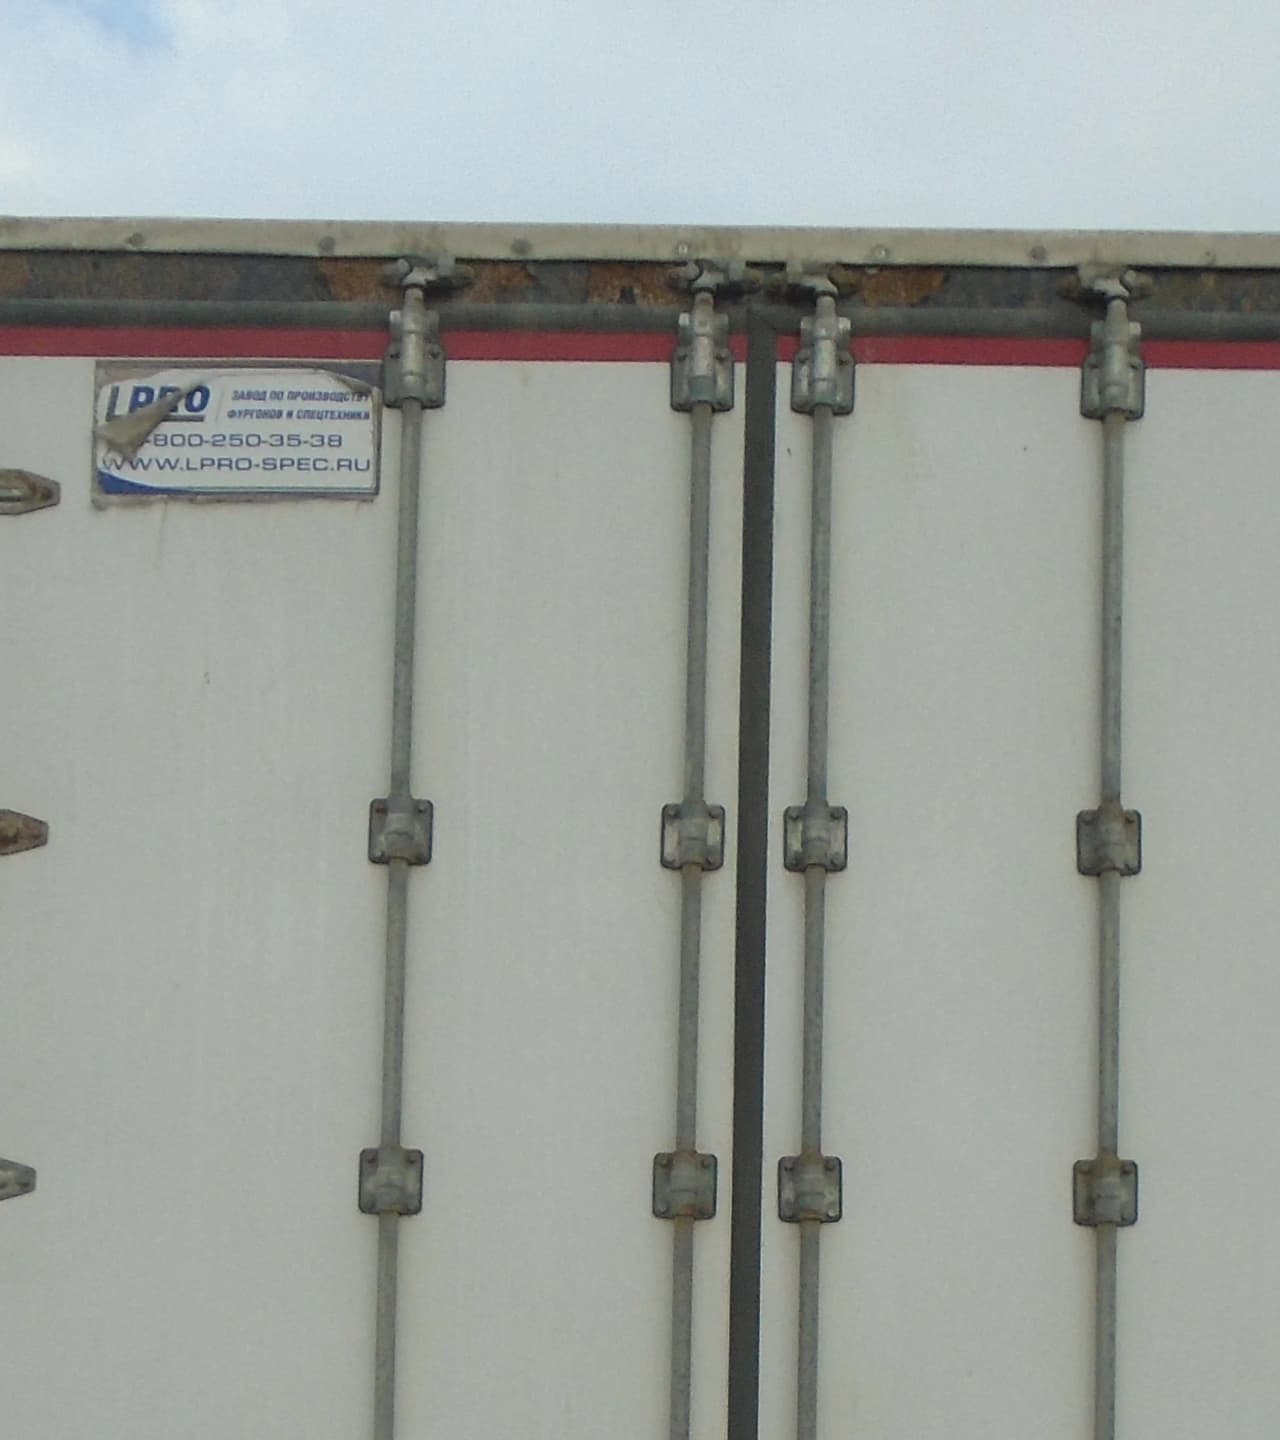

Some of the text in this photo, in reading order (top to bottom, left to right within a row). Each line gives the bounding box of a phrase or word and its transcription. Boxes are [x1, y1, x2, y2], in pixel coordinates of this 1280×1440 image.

[232, 390, 267, 401] ЗАВОД
[269, 390, 284, 401] ПО
[227, 408, 370, 420] ФУРГОНОВ И СПЕЦТЕХНИКИ
[102, 457, 371, 472] WWW.LPRO-SPEC.RU
